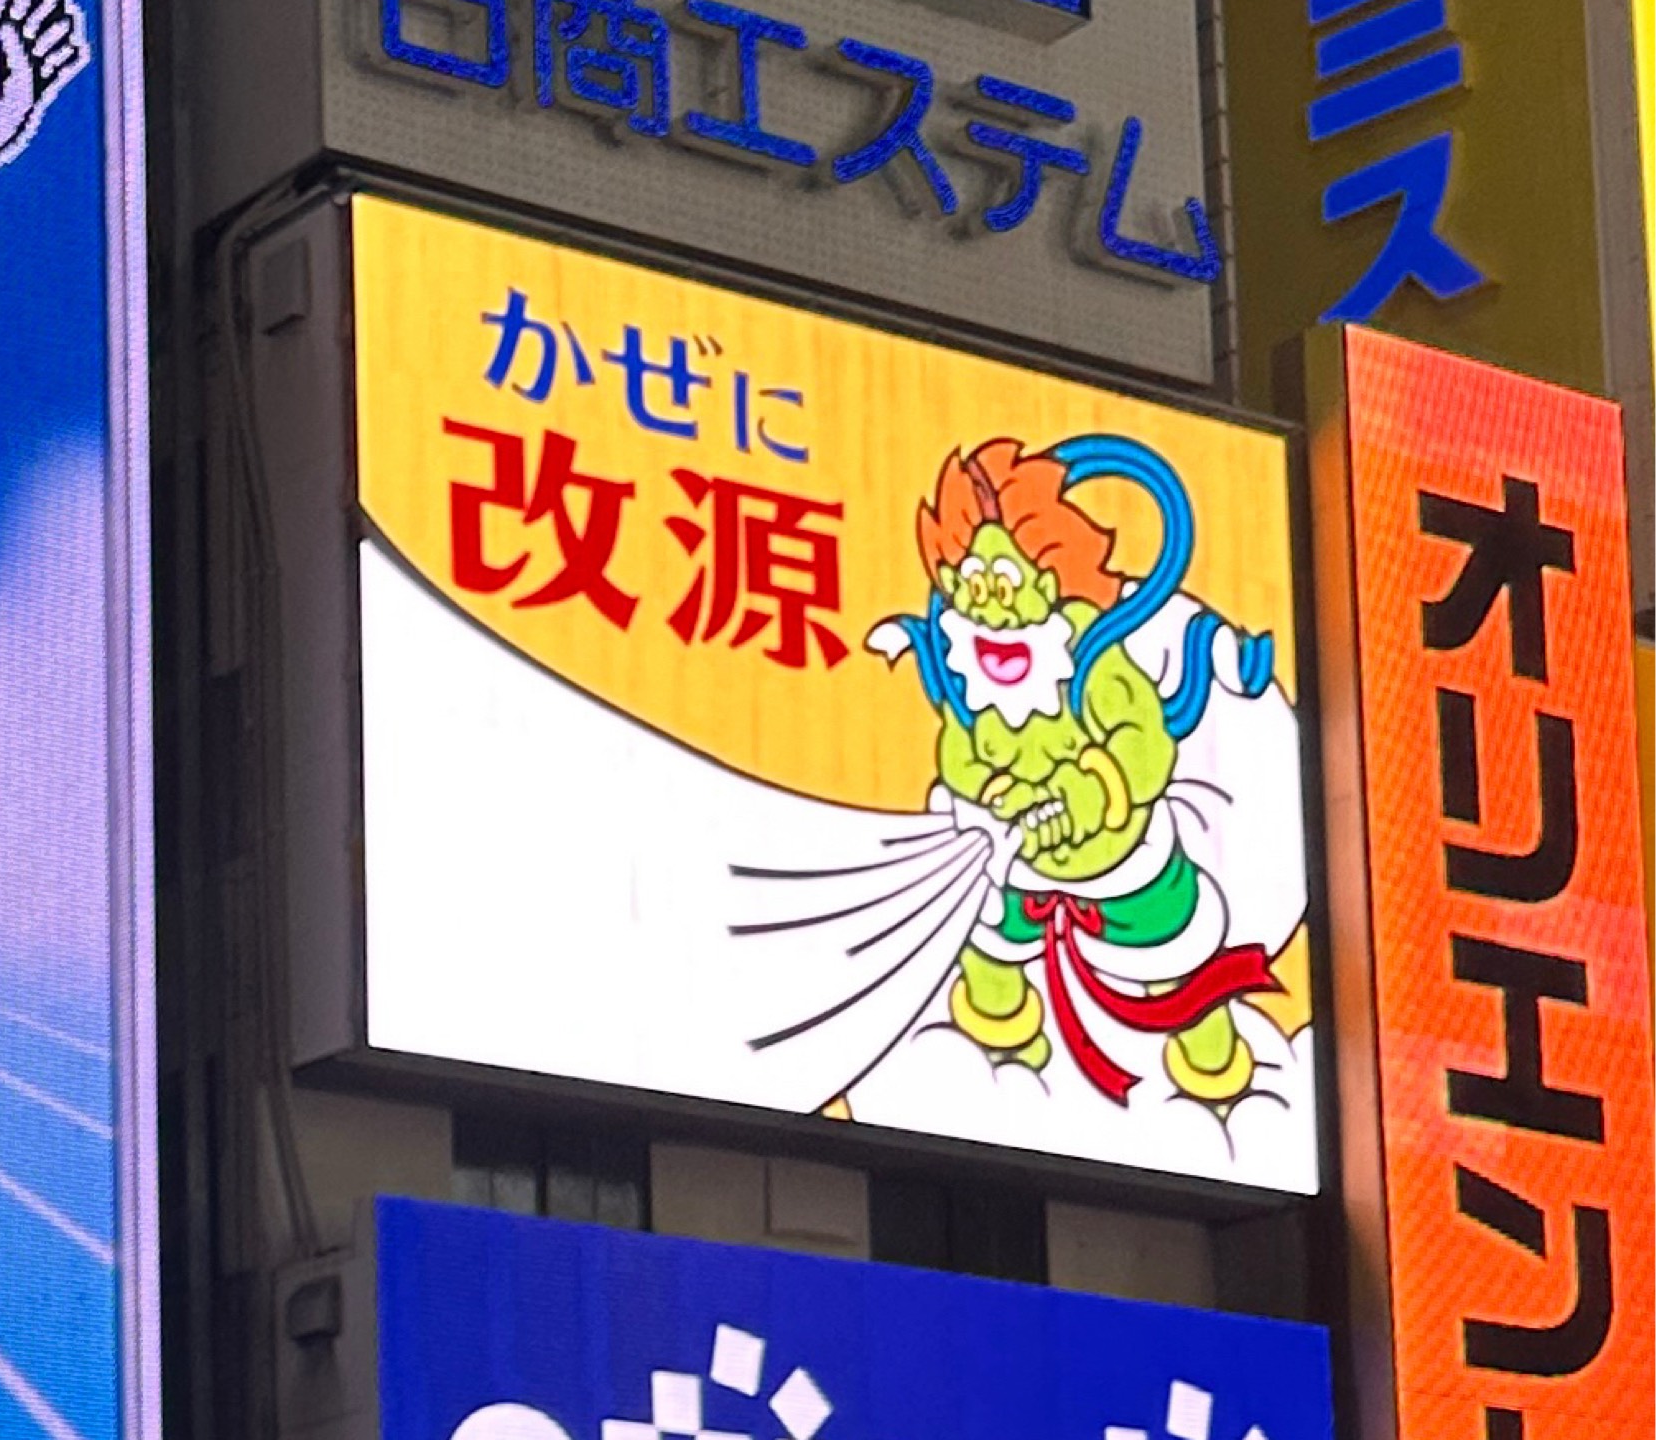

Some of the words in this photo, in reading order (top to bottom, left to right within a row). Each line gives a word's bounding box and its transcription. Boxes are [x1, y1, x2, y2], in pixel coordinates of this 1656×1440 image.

[481, 287, 810, 464] かぜに
[441, 417, 851, 670] 改源
